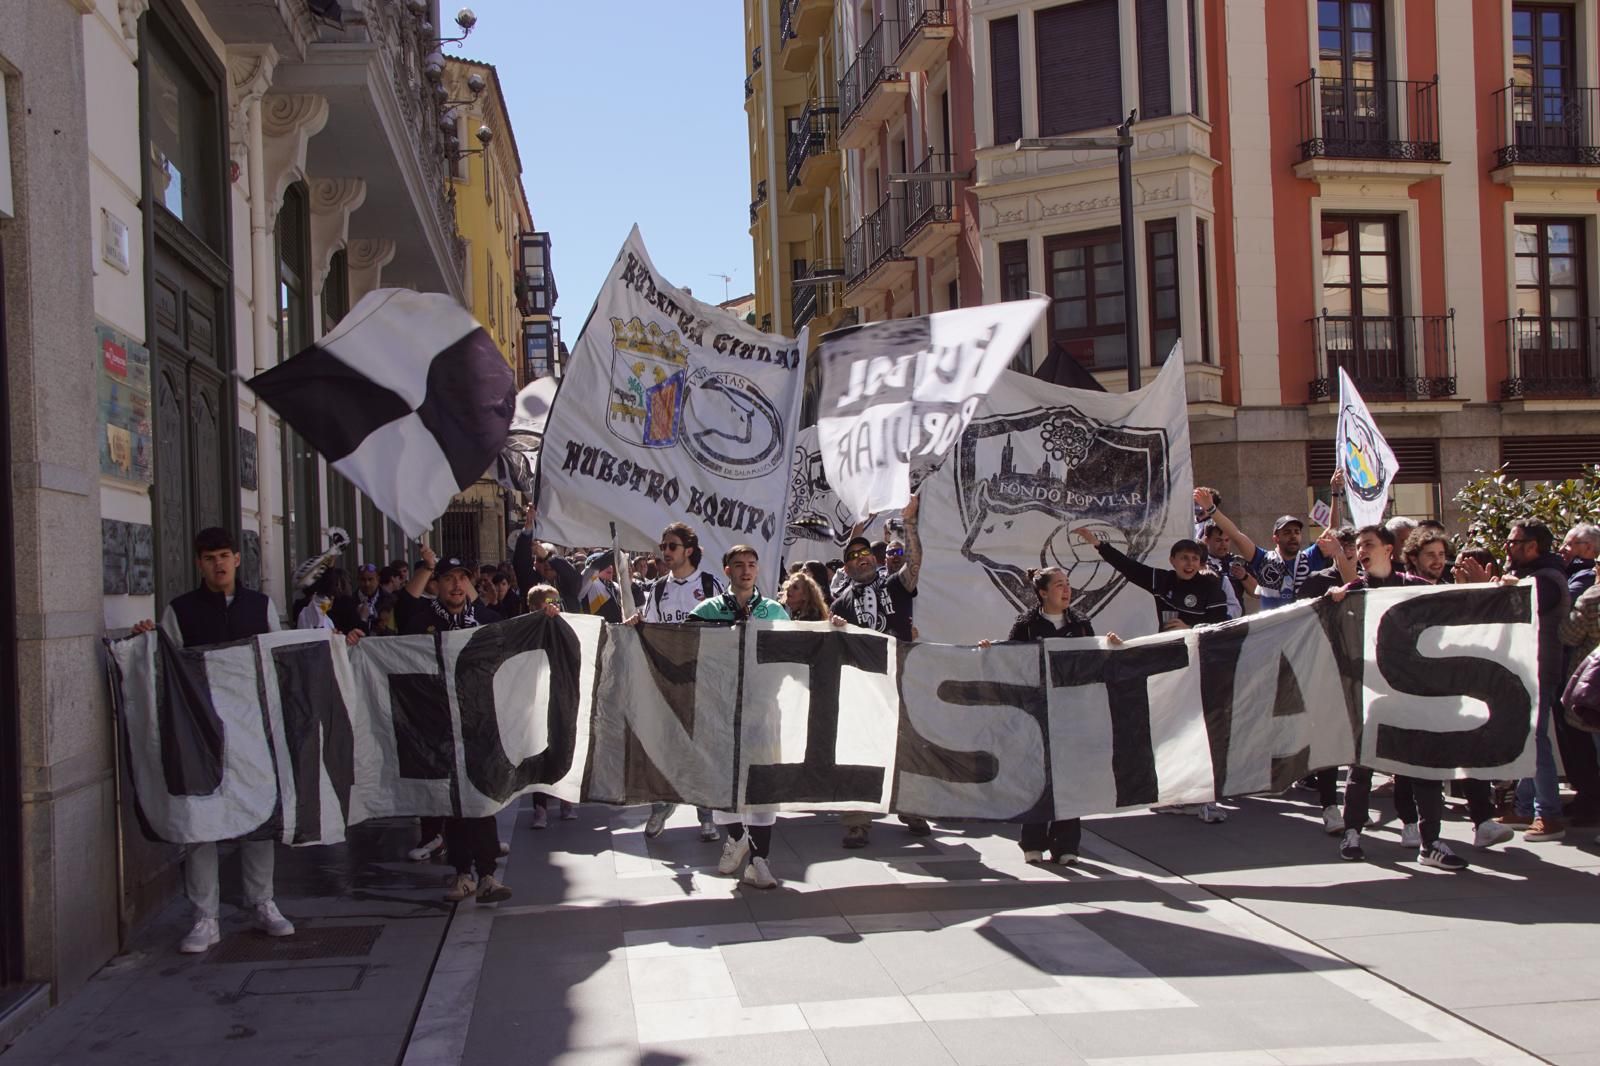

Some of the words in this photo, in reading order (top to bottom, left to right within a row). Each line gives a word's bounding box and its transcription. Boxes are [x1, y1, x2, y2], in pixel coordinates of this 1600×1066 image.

[561, 440, 680, 506] NUESTRO
[686, 486, 776, 543] EQUIPO
[999, 482, 1061, 503] FONDO
[662, 611, 673, 622] La
[108, 584, 1532, 845] UNIONISTAS
